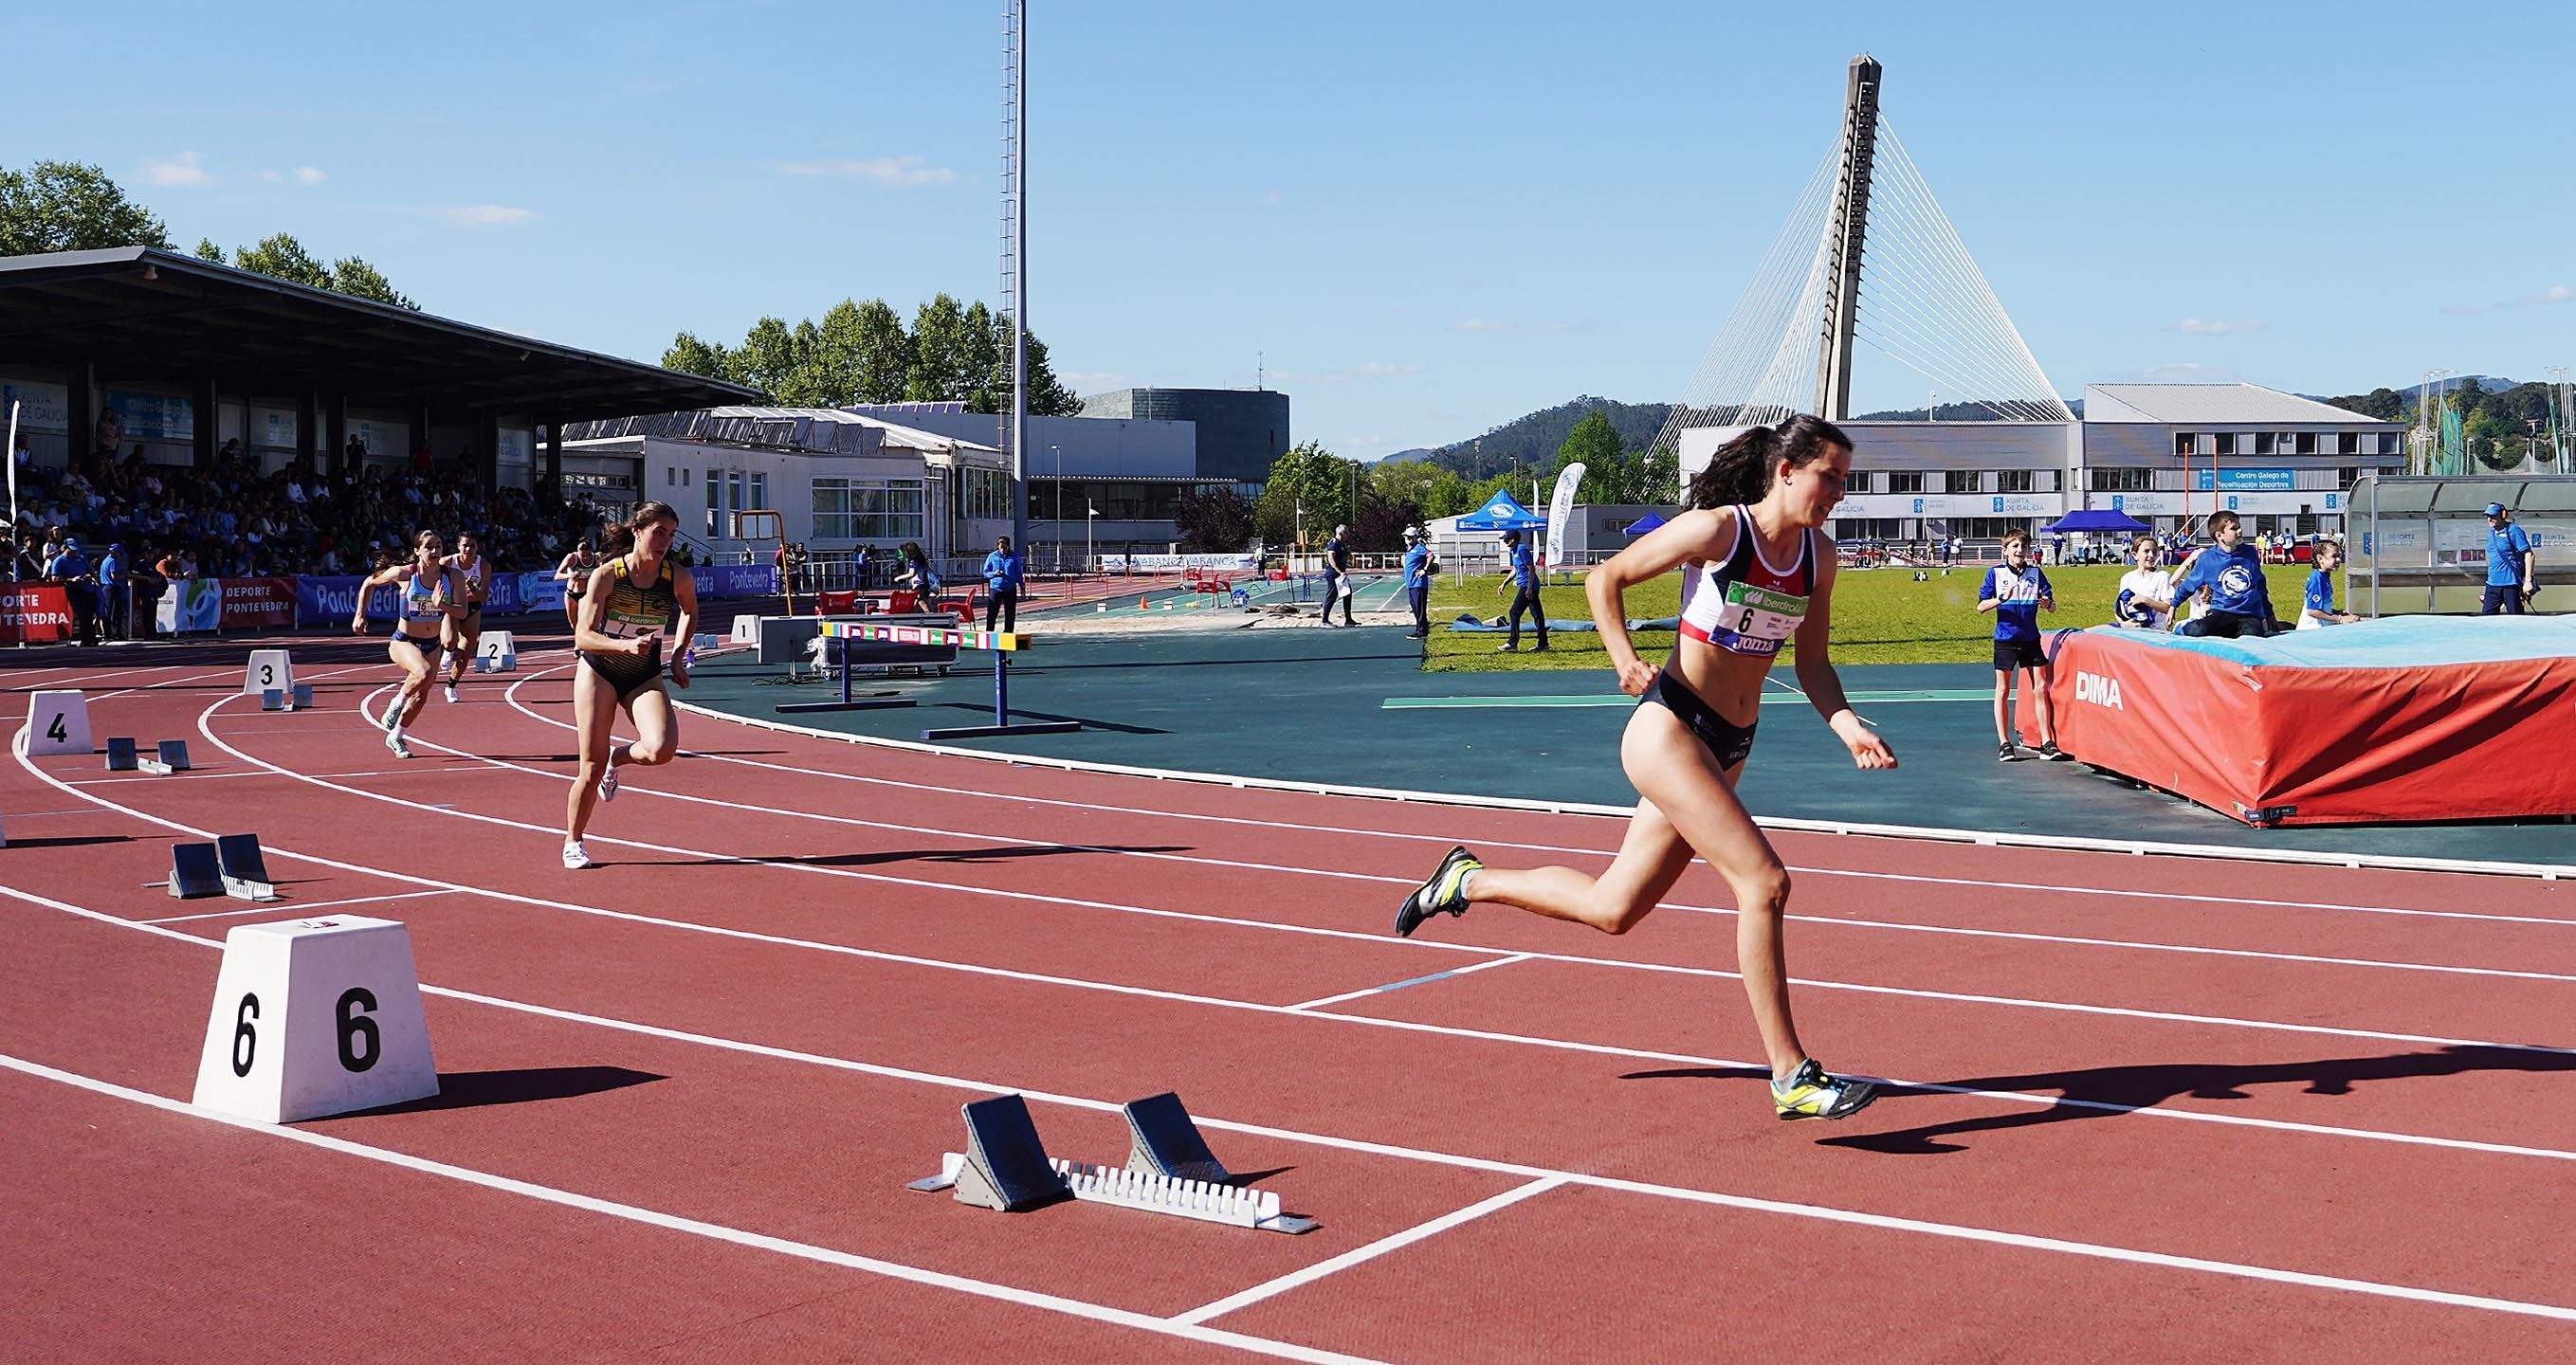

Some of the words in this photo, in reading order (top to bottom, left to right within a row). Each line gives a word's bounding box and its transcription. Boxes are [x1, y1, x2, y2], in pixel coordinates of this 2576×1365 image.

[2259, 481, 2289, 489] Deportiva
[729, 567, 769, 589] Pontevedra
[0, 593, 39, 608] ORTE
[226, 586, 271, 598] DEPORTE
[226, 601, 289, 613] PONTEVEDRA
[740, 624, 747, 638] 1
[1738, 608, 1755, 633] 6
[488, 643, 499, 660] 2
[260, 664, 273, 685] 3
[2074, 670, 2124, 711] DIMA
[46, 712, 67, 743] 4
[232, 992, 260, 1078] 6
[335, 987, 381, 1073] 6
